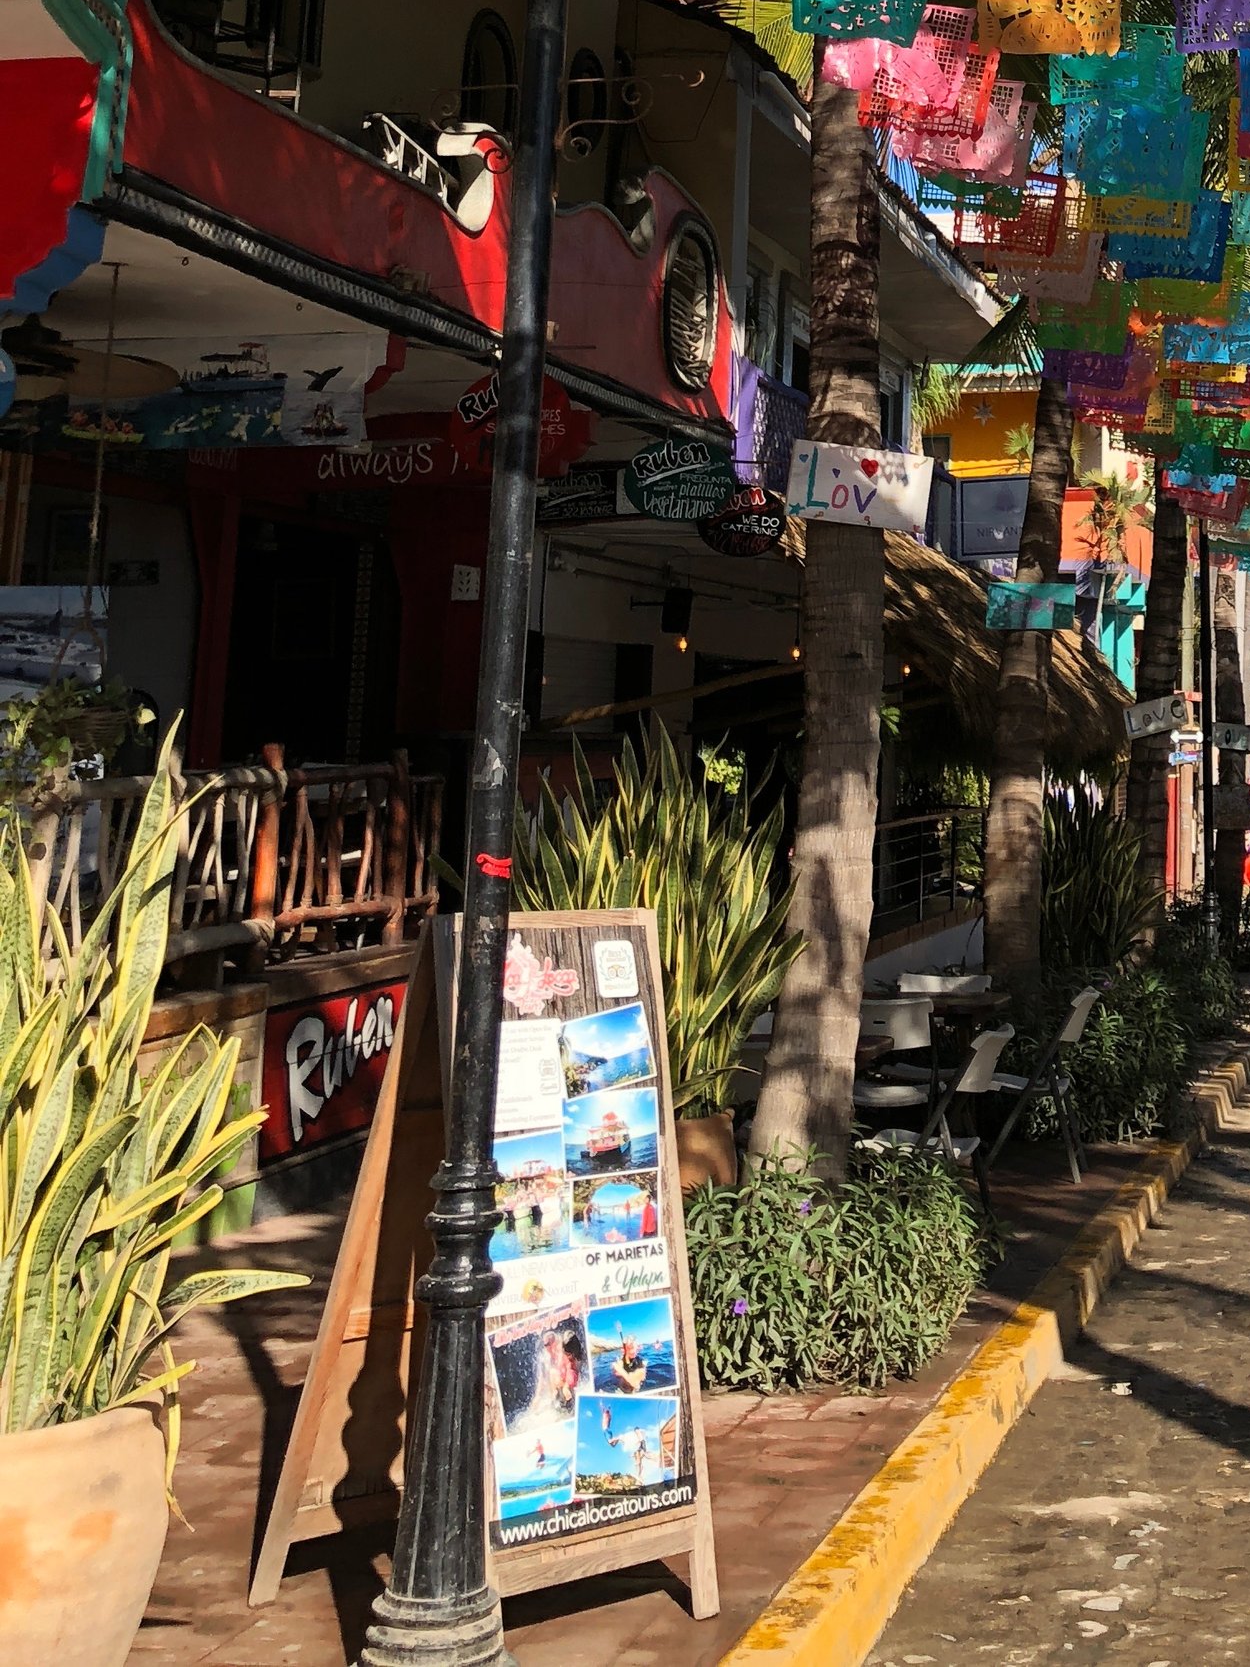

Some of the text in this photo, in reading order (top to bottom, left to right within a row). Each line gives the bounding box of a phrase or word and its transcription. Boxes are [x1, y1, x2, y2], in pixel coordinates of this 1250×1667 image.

[632, 440, 710, 478] Ruben
[721, 522, 778, 537] CATERING
[742, 515, 780, 528] WE DO
[977, 525, 1022, 539] NIRVAN
[286, 996, 394, 1142] Ruben
[586, 1252, 602, 1266] OF
[606, 1243, 665, 1263] MARIETAS
[615, 1265, 665, 1299] Yelapa
[500, 1485, 692, 1545] www.chicaloccatours.com
